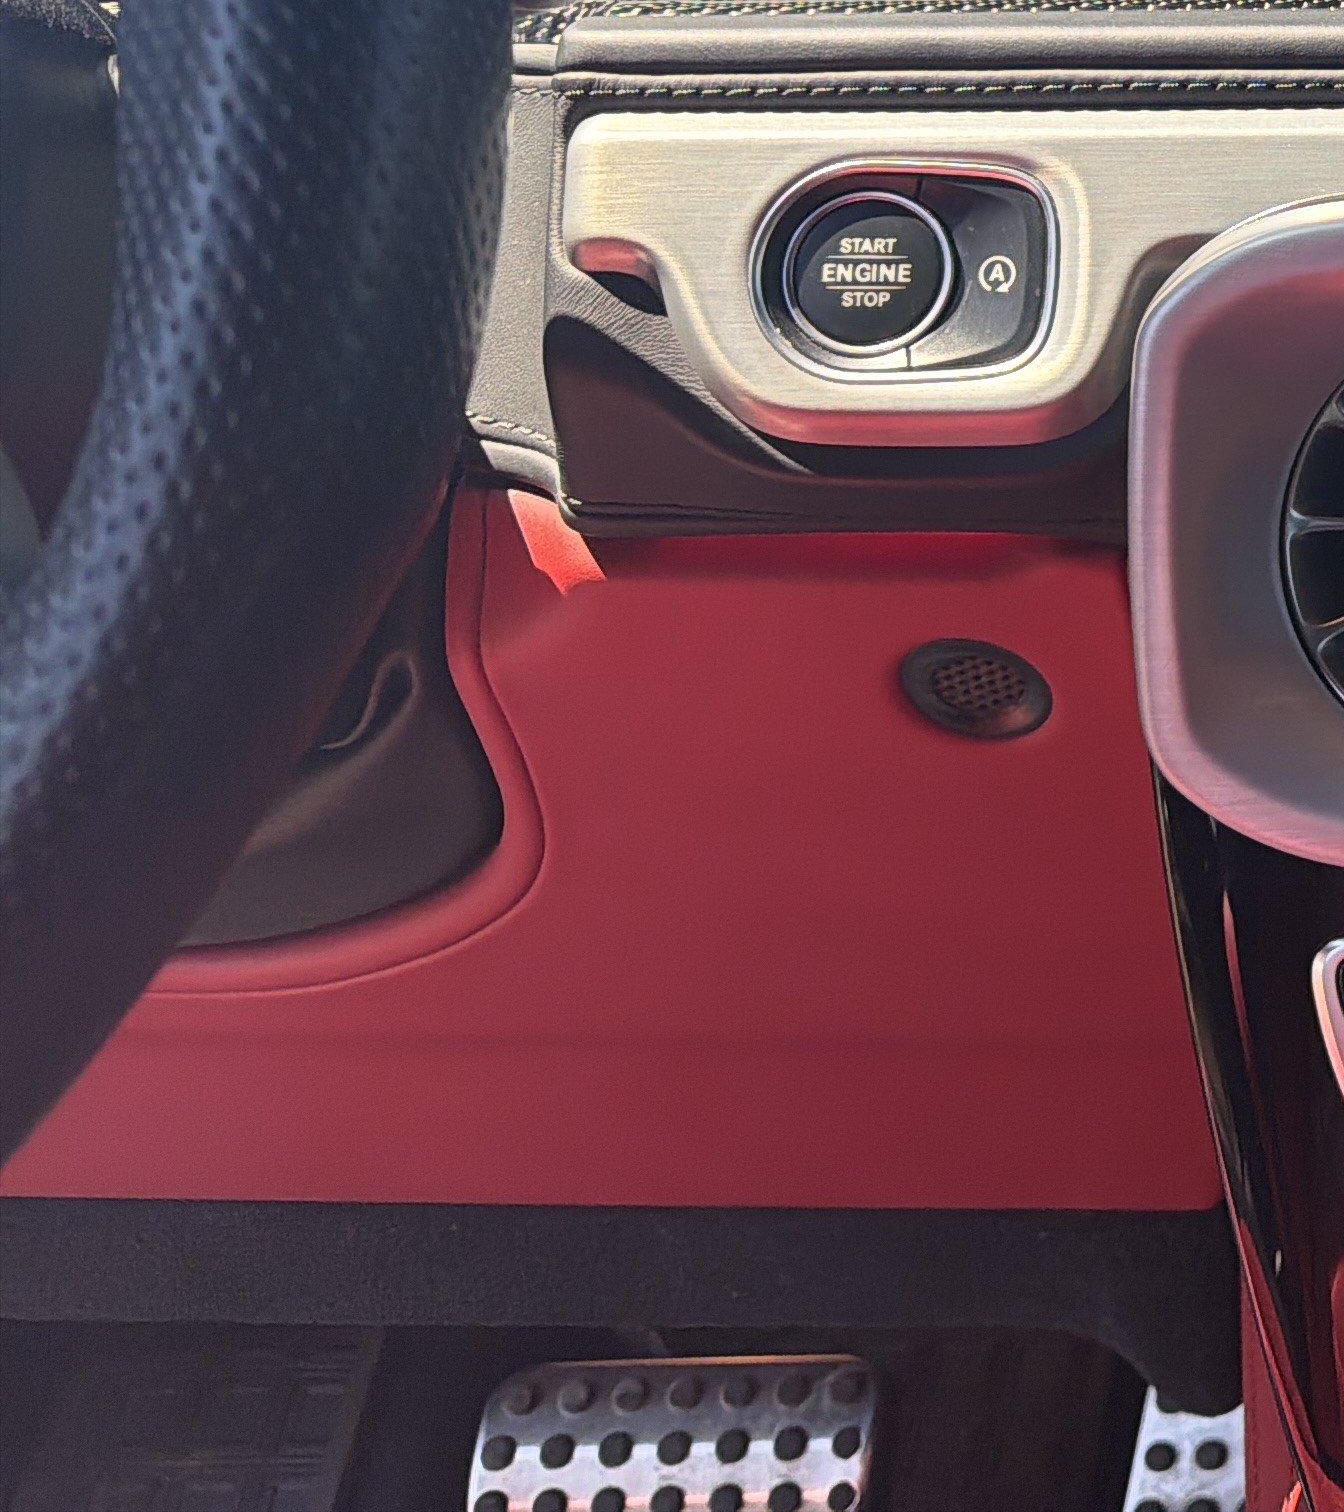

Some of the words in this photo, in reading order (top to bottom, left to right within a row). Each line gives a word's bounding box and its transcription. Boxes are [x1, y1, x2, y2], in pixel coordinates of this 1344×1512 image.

[840, 238, 898, 255] START
[821, 263, 912, 283] ENGINE
[988, 264, 1006, 282] A
[841, 291, 891, 307] STOP
